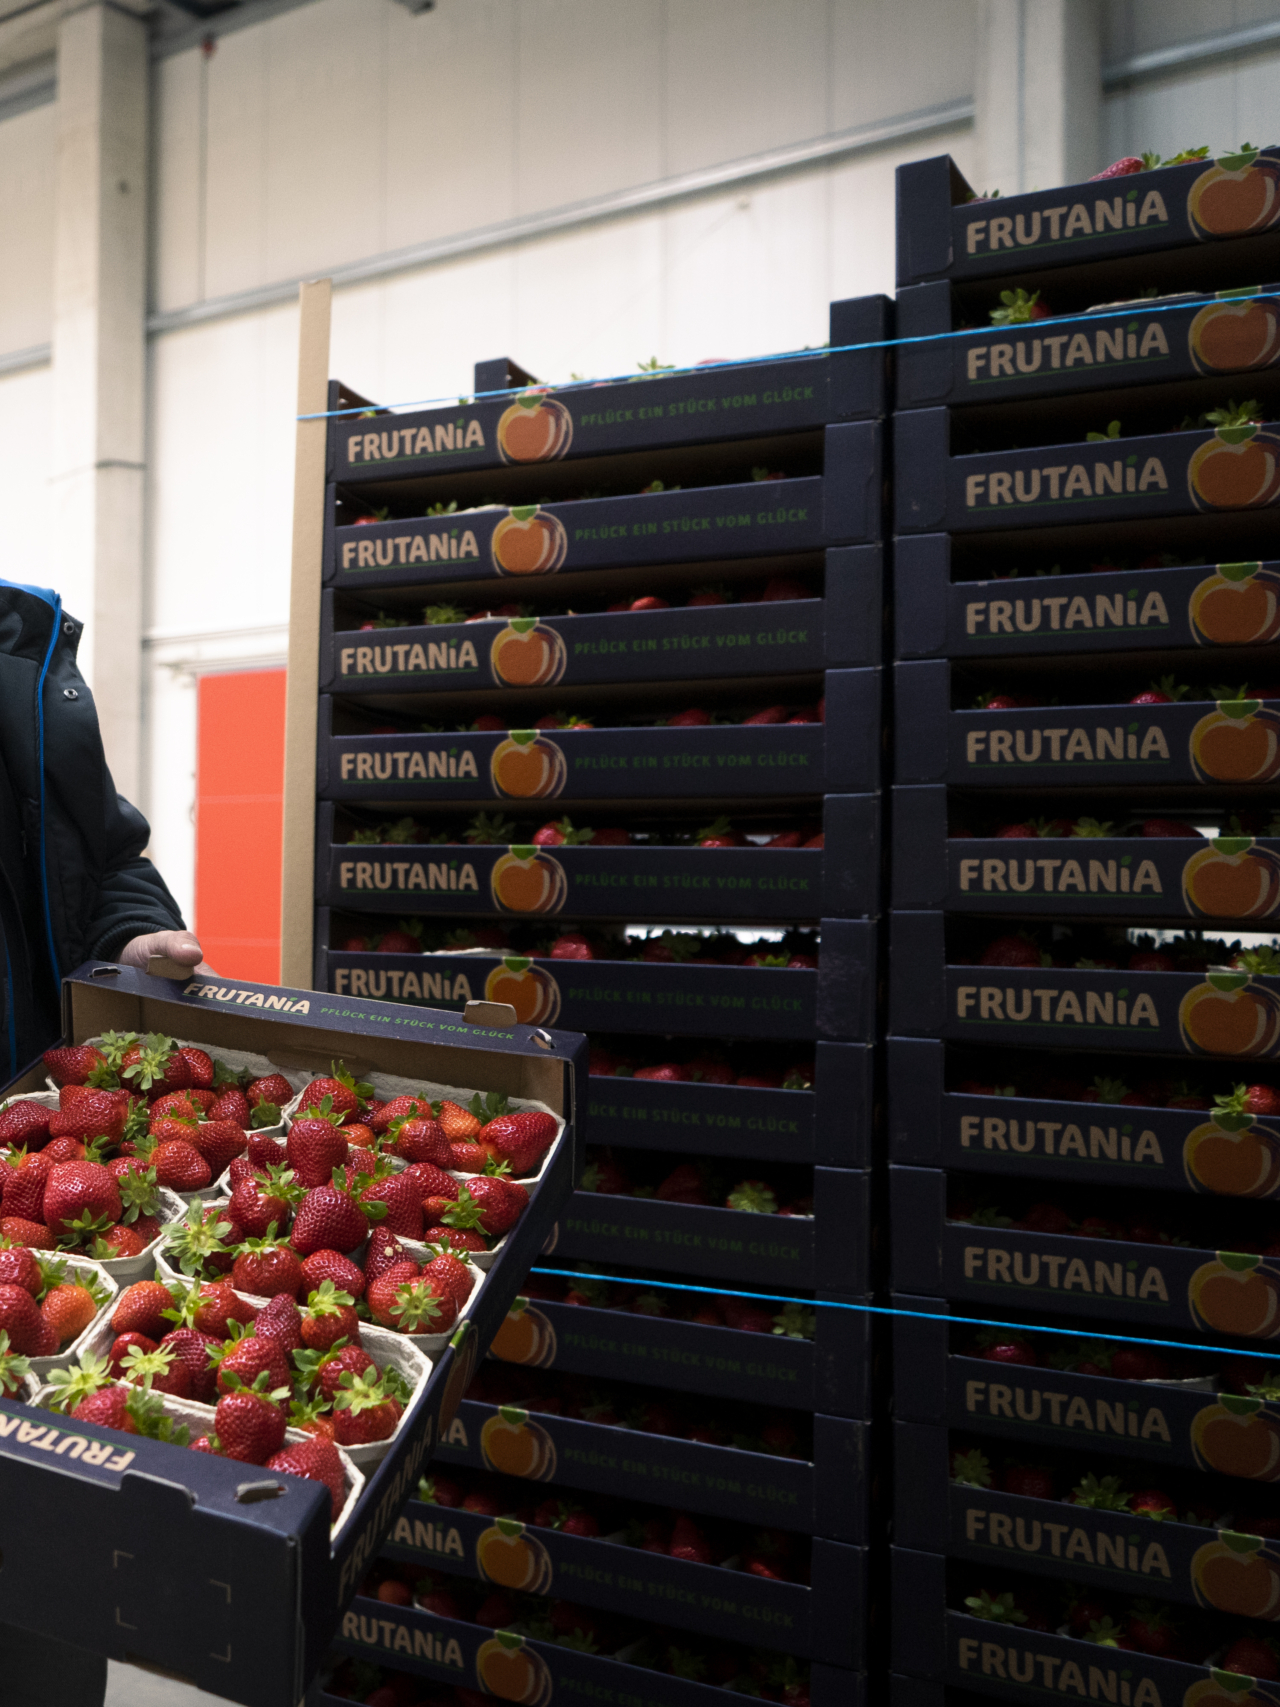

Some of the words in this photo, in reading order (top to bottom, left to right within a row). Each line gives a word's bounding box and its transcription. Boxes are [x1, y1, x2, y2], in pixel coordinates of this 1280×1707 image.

[581, 410, 633, 426] PFLÜCK
[638, 406, 663, 419] EIN
[669, 399, 716, 417] STÜCK
[722, 394, 757, 408] VOM
[763, 386, 813, 404] GLÜCK
[575, 524, 627, 540] PFLÜCK
[632, 522, 657, 536] EIN
[662, 516, 710, 533] STÜCK
[716, 514, 751, 527] VOM
[757, 507, 808, 524] GLÜCK
[574, 639, 627, 654] PFLÜCK
[632, 639, 657, 652] EIN
[662, 634, 710, 650] STÜCK
[716, 633, 751, 647] VOM
[756, 628, 808, 645] GLÜCK
[575, 754, 627, 769] PFLÜCK
[633, 756, 657, 768] EIN
[663, 753, 710, 768] STÜCK
[716, 754, 752, 767] VOM
[757, 750, 808, 767] GLÜCK
[575, 872, 628, 887] PFLÜCK
[633, 874, 657, 887] EIN
[663, 873, 711, 889] STÜCK
[716, 876, 752, 890] VOM
[758, 875, 809, 891] GLÜCK
[320, 1007, 366, 1020] PFLÜCK
[370, 1014, 391, 1023] EIN
[394, 1017, 435, 1029] STÜCK
[439, 1024, 468, 1034] VOM
[472, 1029, 515, 1040] GLÜCK
